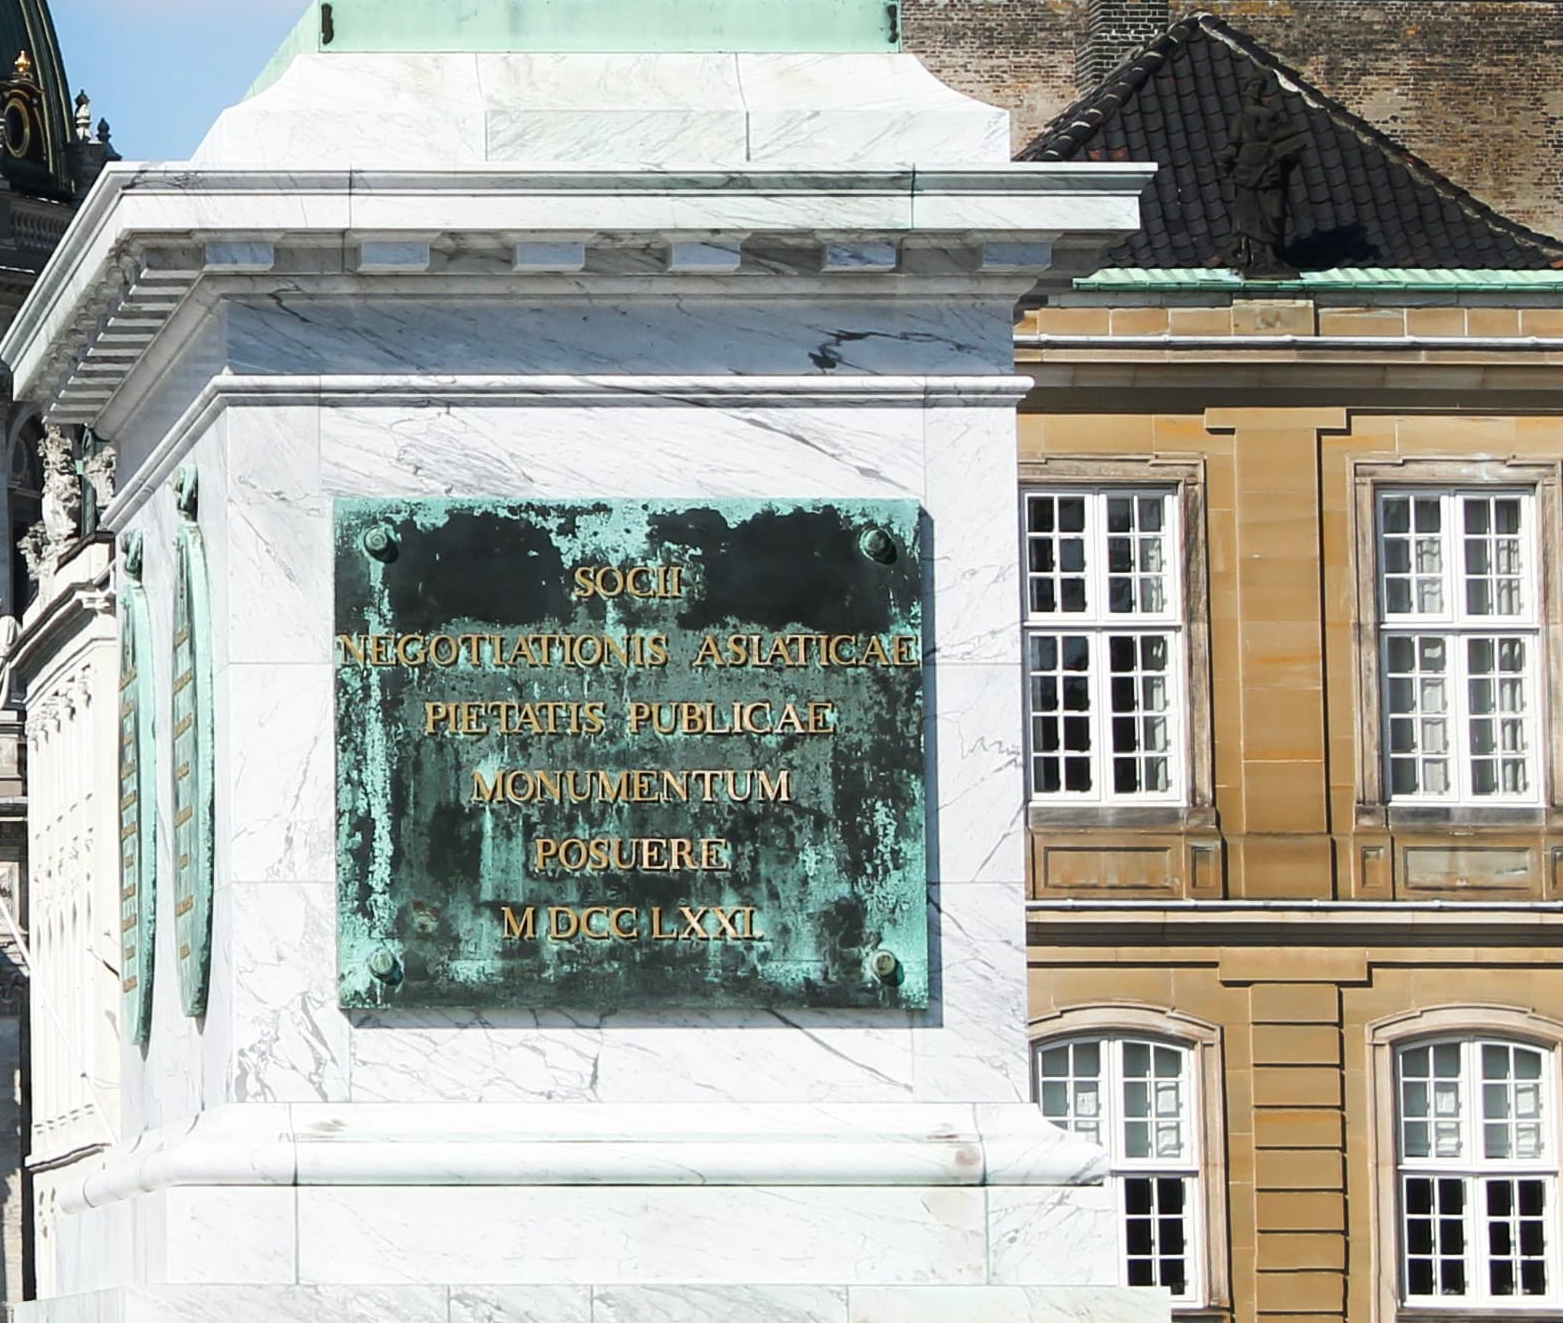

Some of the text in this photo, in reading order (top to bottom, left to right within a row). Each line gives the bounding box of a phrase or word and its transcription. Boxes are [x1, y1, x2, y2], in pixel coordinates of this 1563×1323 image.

[574, 565, 684, 598] SOCII
[338, 634, 920, 668] NEGOTIATIONIS ASIATICAE
[426, 701, 835, 734] PIETATIS PUBLICAE
[471, 769, 792, 803] MONUMENTUM
[534, 838, 730, 871] POSUERE
